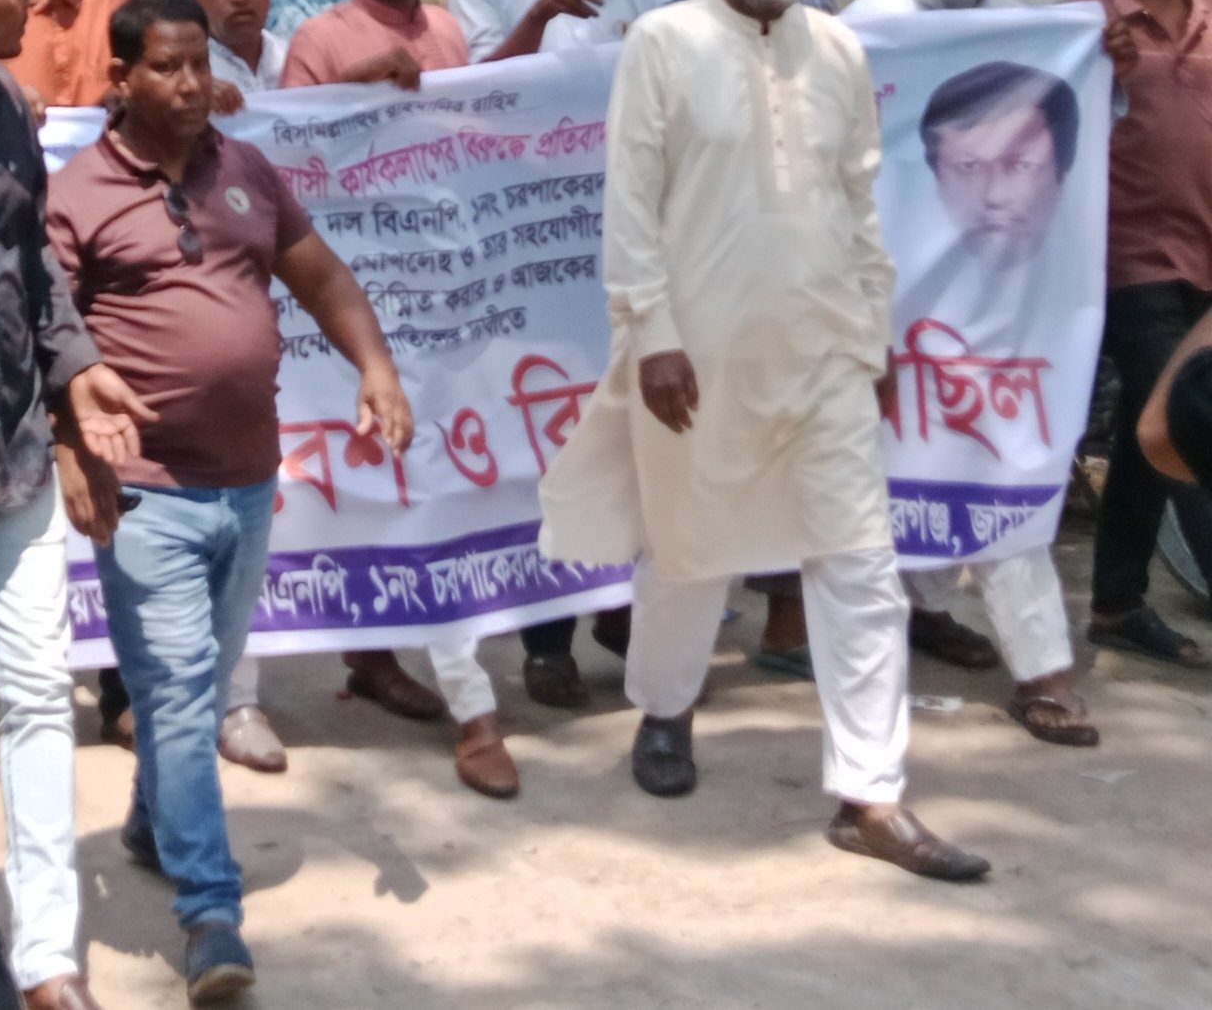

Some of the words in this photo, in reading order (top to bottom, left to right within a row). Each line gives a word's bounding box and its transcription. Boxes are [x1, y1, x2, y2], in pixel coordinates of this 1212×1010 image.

[338, 138, 460, 198] কার্যকলাপের
[325, 211, 364, 237] দল
[460, 246, 475, 267] ও
[511, 254, 597, 288] আজকের
[434, 407, 498, 488] ও
[368, 564, 428, 614] ১নং
